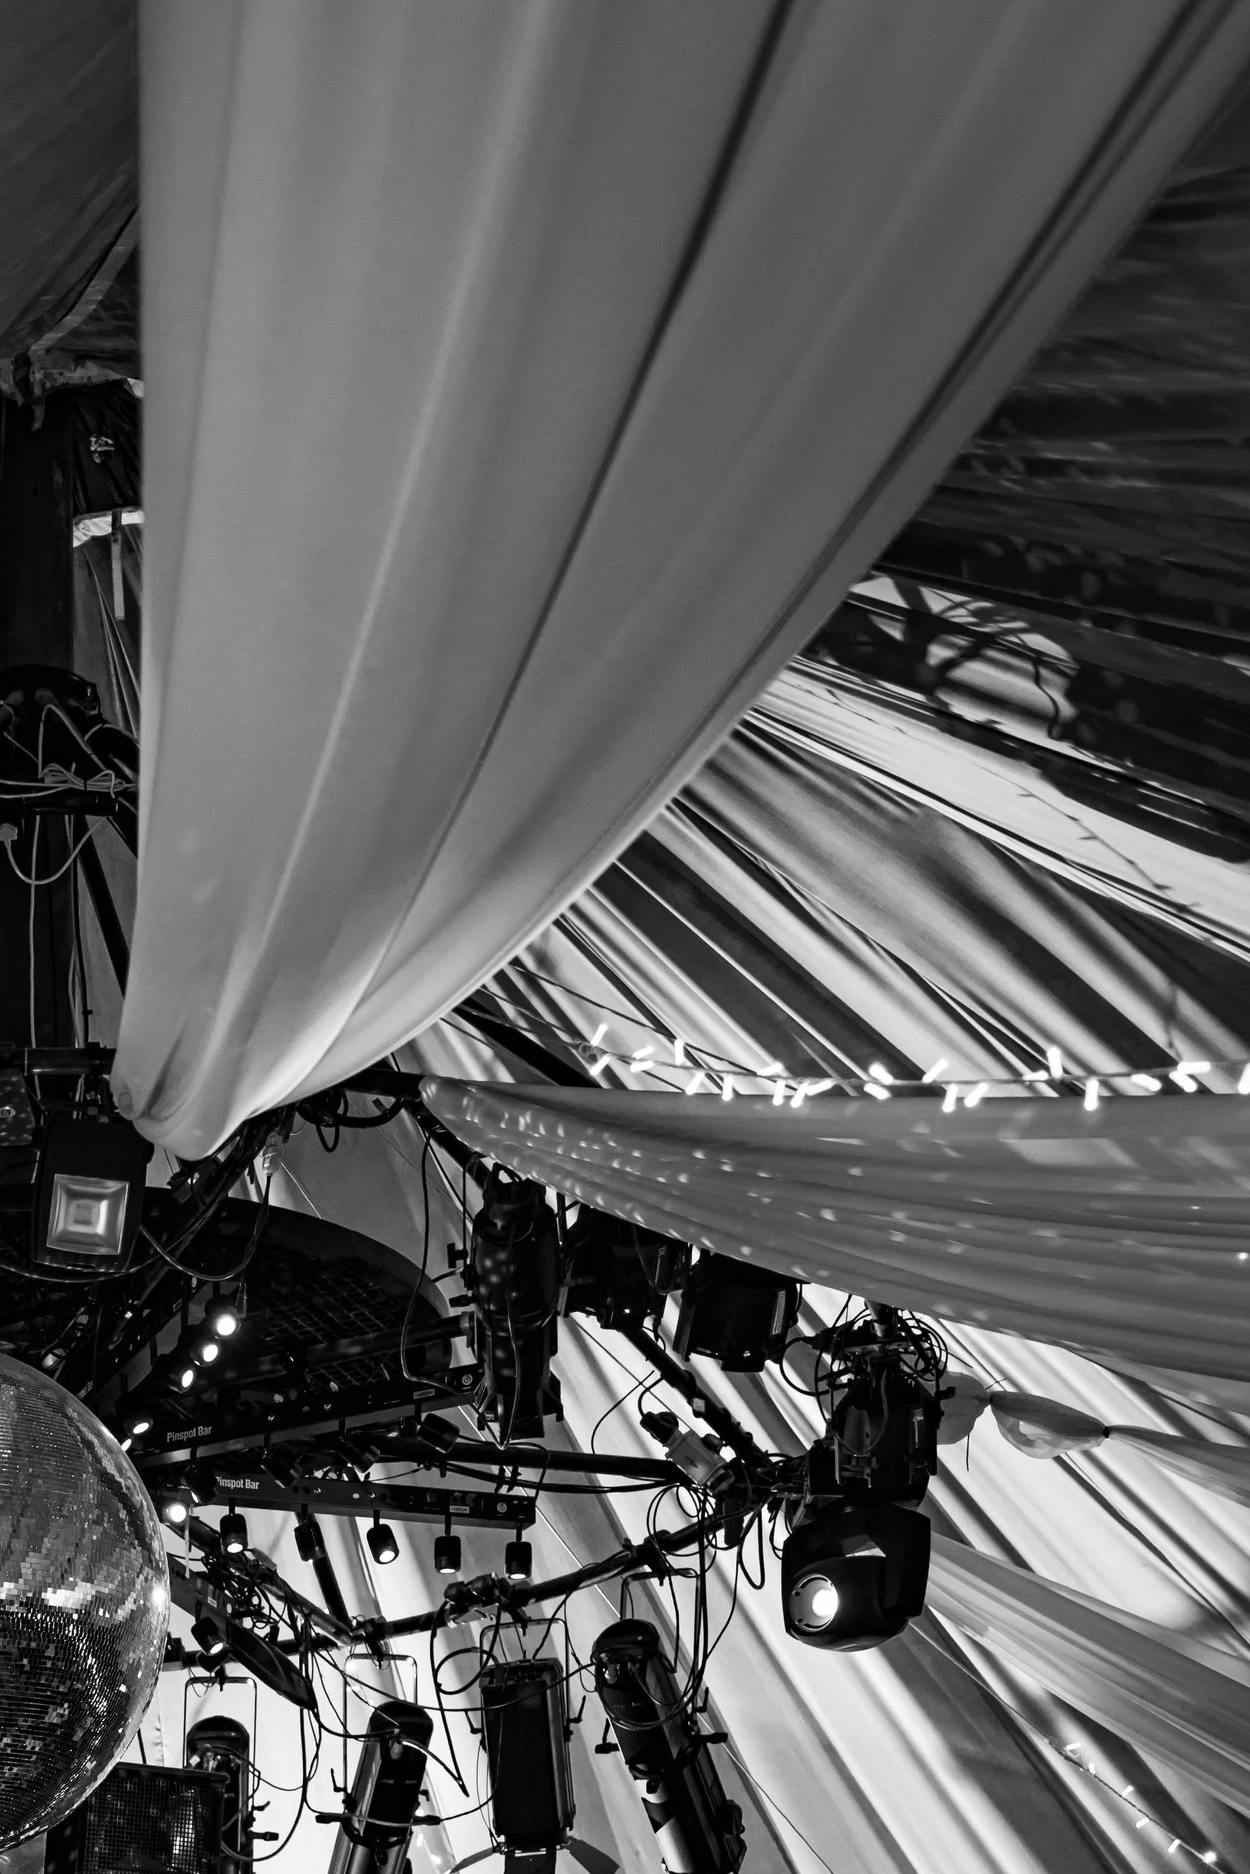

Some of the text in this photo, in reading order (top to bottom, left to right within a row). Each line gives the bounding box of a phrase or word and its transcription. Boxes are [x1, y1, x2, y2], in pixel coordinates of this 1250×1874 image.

[167, 1425, 212, 1443] Pinspot Bar
[245, 1479, 260, 1490] Bar
